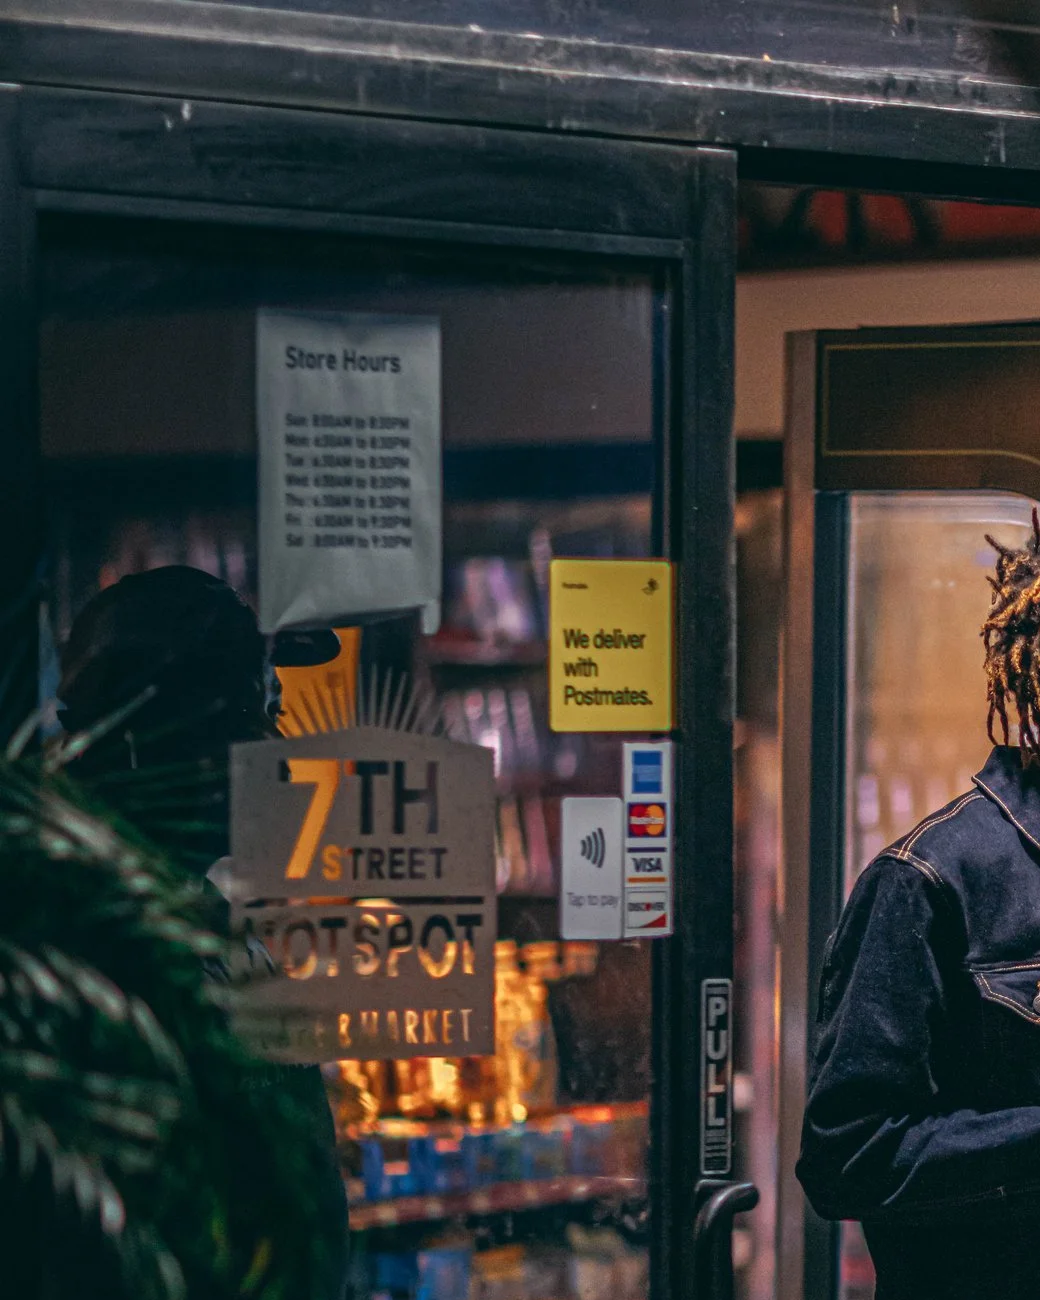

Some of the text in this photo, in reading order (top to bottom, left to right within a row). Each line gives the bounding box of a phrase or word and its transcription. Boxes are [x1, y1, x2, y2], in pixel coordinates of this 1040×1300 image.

[285, 346, 401, 373] Store Hours
[563, 628, 646, 649] We deliver
[563, 656, 599, 678] with
[563, 685, 653, 706] Postmates.
[278, 758, 439, 881] 7TH
[322, 845, 448, 881] STREET
[632, 857, 664, 873] VISA
[567, 892, 619, 909] Tap to pay
[707, 996, 728, 1127] PULL
